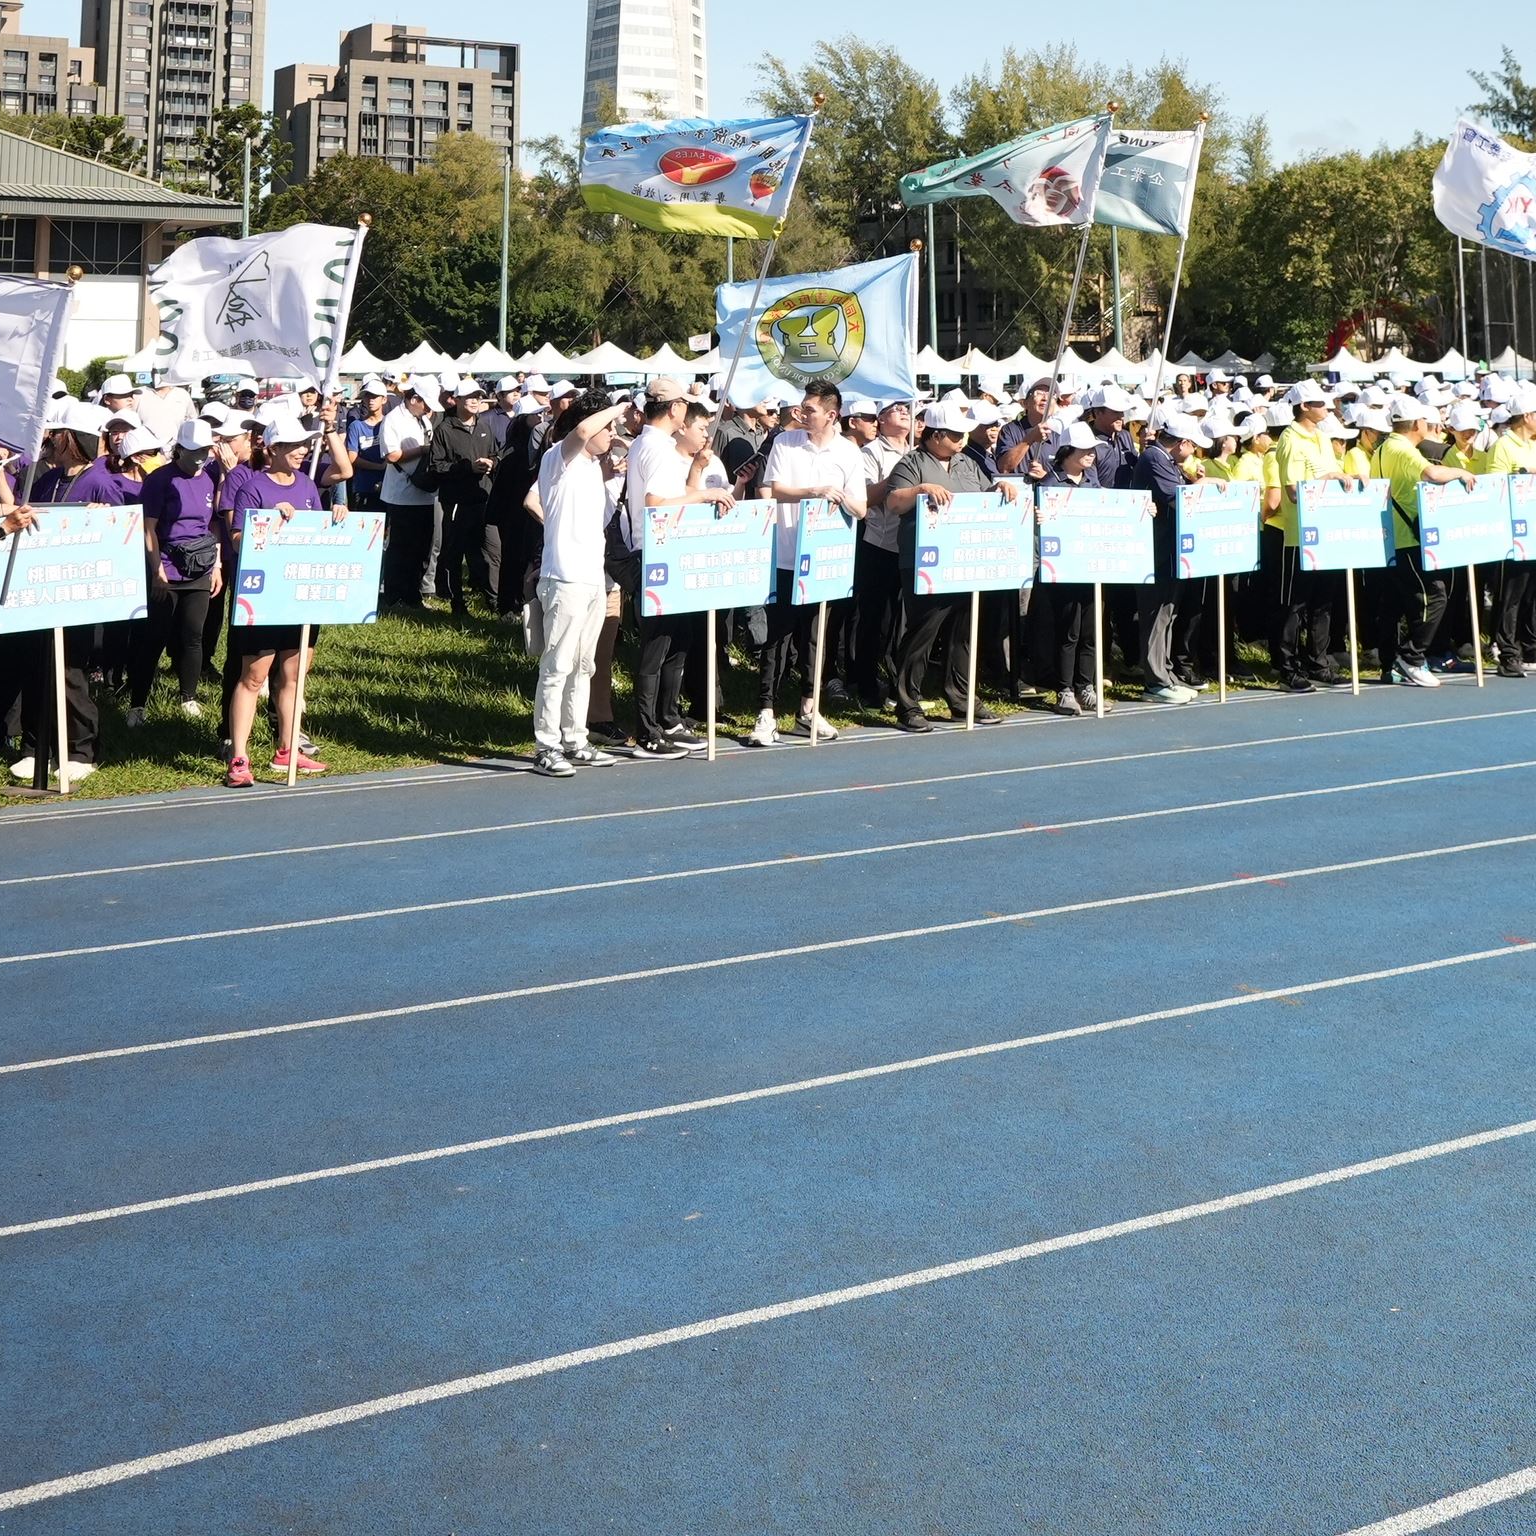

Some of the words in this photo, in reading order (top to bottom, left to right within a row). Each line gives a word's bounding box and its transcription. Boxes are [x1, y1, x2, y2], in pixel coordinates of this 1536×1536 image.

[1515, 522, 1527, 535] 35
[1304, 530, 1317, 543] 37
[1426, 531, 1439, 544] 36
[1044, 541, 1059, 553] 39
[1182, 537, 1193, 550] 38
[922, 551, 937, 563] 40
[800, 559, 809, 572] 41
[649, 568, 665, 582] 42
[243, 575, 262, 590] 45
